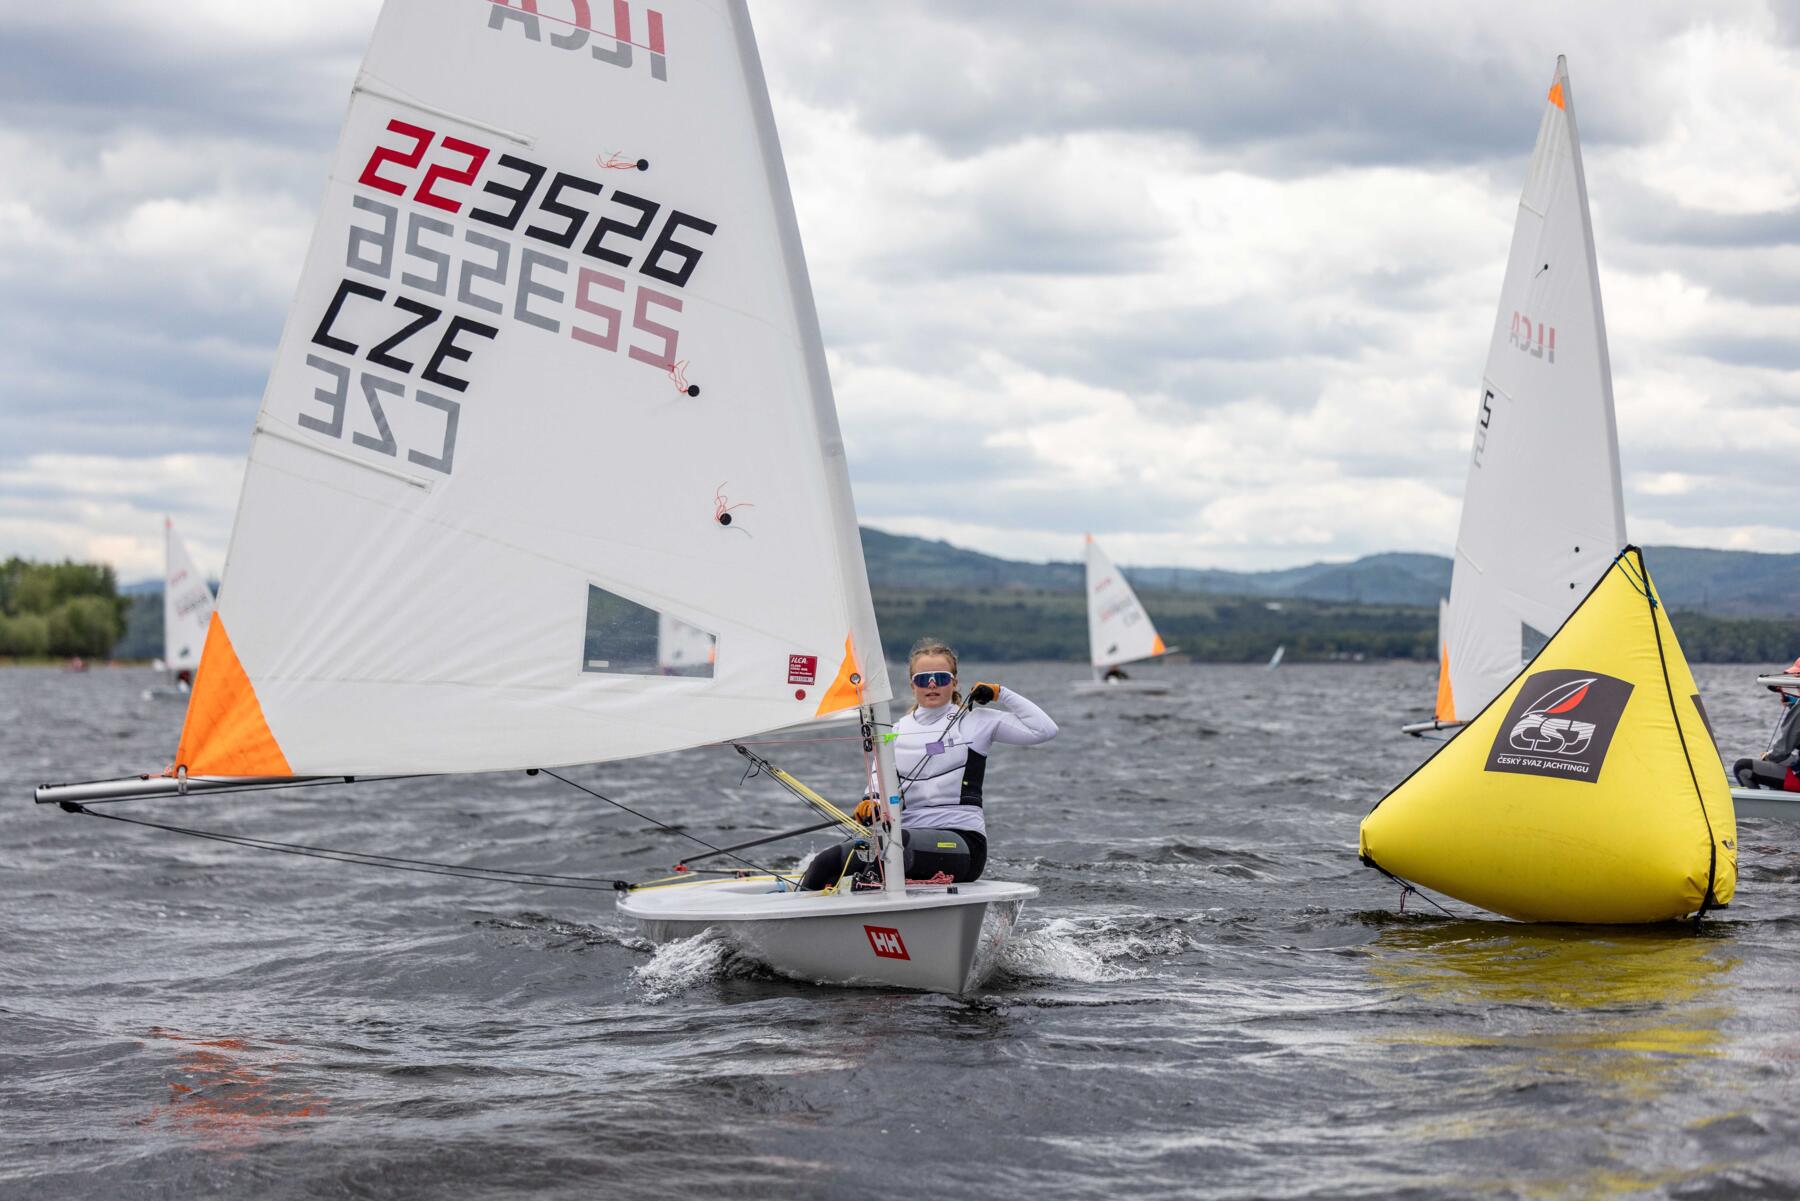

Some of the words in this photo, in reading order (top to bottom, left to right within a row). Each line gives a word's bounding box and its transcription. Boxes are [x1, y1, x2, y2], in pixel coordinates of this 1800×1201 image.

[358, 119, 717, 288] 223526
[311, 279, 499, 393] CZE
[1497, 755, 1521, 765] ČESKÝ
[1522, 758, 1542, 767] SVAZ
[1542, 760, 1589, 773] JACHTINGU
[870, 931, 903, 954] HH
